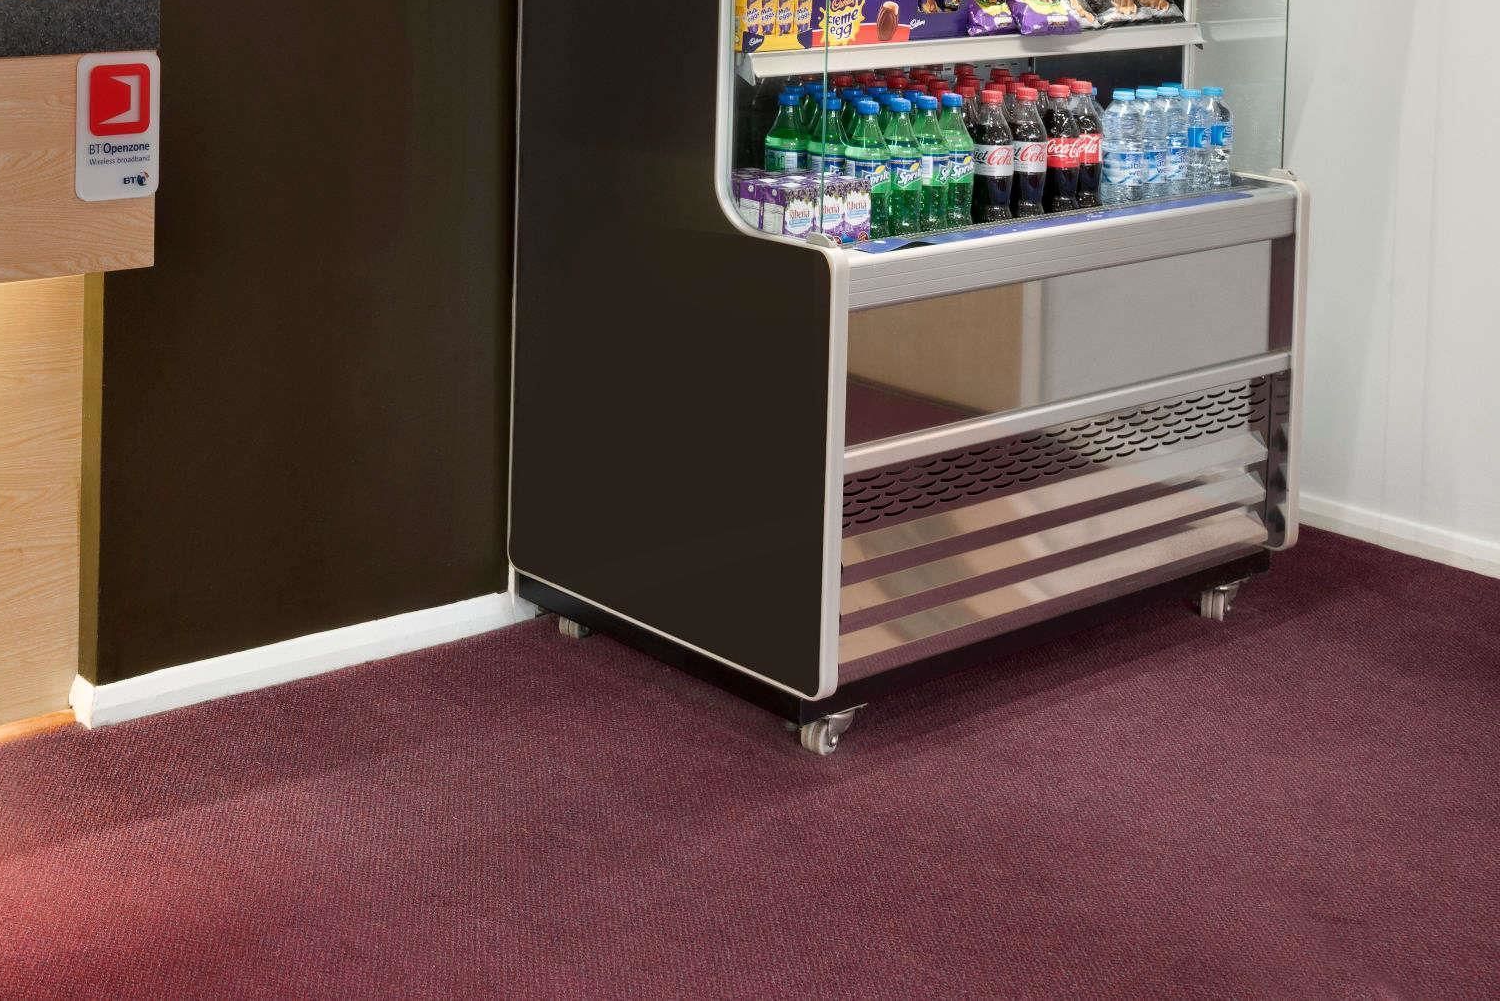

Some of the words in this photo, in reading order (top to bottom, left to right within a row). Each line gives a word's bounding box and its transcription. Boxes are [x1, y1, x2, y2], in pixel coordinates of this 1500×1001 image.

[830, 24, 853, 40] egg
[89, 143, 101, 155] BT
[103, 142, 150, 155] Openzone
[123, 176, 137, 185] BT
